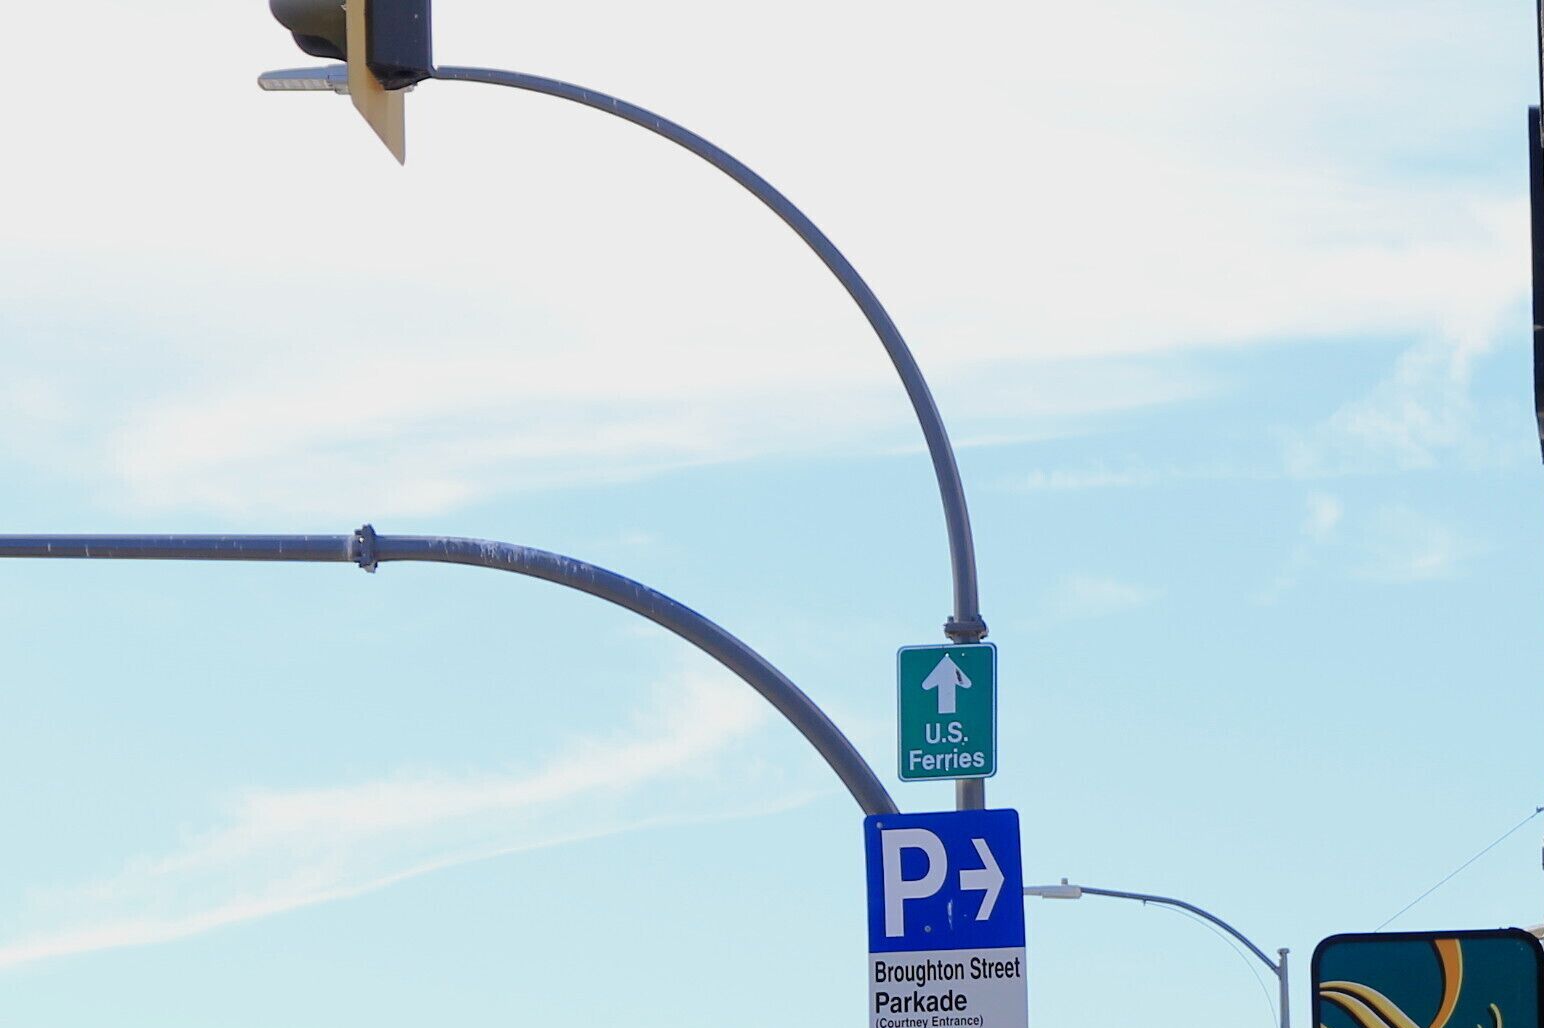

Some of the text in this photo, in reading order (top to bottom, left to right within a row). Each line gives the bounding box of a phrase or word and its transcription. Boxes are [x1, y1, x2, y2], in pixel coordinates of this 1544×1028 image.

[925, 722, 969, 744] U.S.
[909, 748, 985, 771] Ferries
[881, 828, 948, 938] P
[875, 957, 1021, 987] Broughton Street
[875, 989, 968, 1014] Parkade
[932, 1015, 984, 1028] Entrance)
